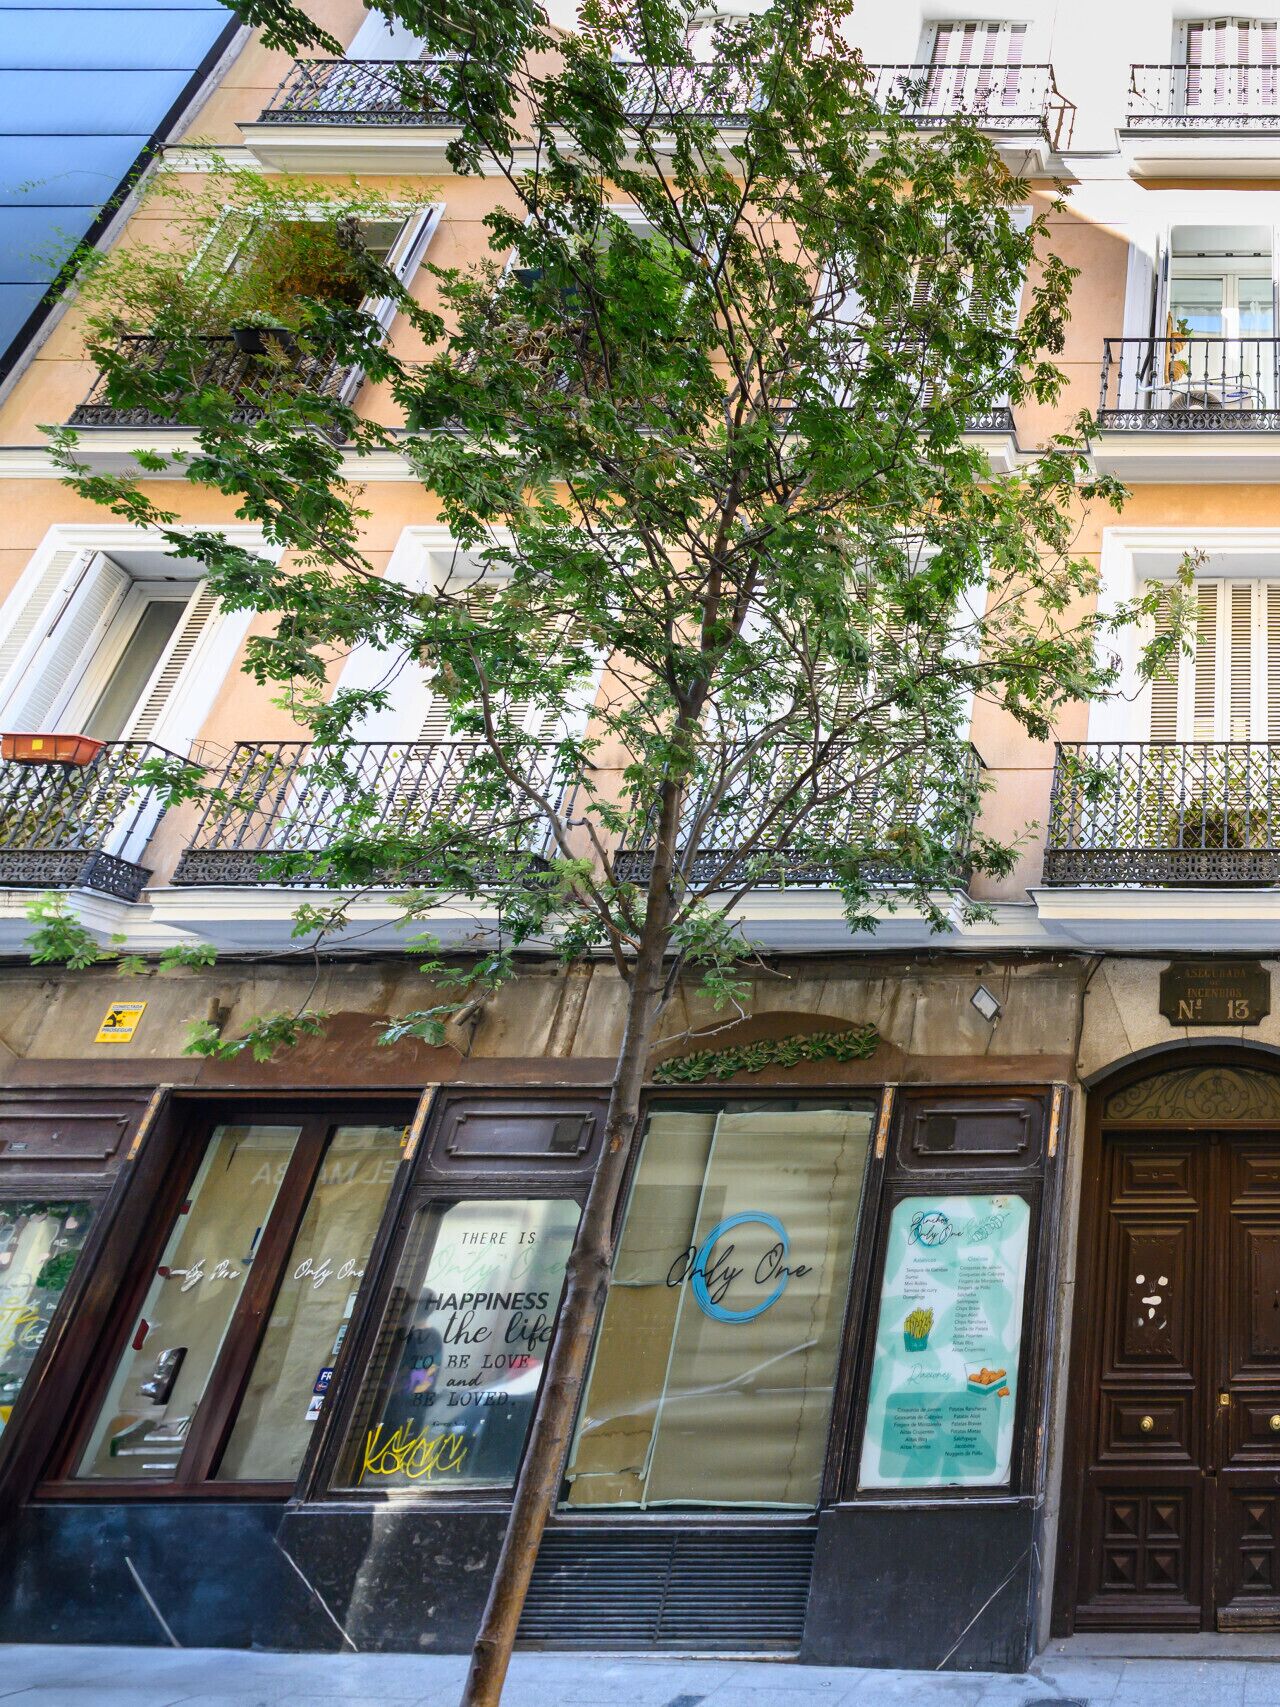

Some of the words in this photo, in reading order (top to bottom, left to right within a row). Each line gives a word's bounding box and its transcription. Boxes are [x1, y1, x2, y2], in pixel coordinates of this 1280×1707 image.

[1186, 987, 1242, 998] INCENDIOS
[1226, 999, 1250, 1020] 13
[461, 1231, 508, 1245] THERE
[518, 1231, 536, 1245] IS
[938, 1223, 964, 1246] One
[293, 1258, 333, 1289] Only
[666, 1244, 744, 1305] Only
[754, 1242, 813, 1285] One
[425, 1292, 550, 1311] HAPPINESS
[442, 1310, 493, 1345] the
[504, 1311, 553, 1352] life
[412, 1354, 434, 1370] TO
[447, 1354, 471, 1369] BE
[481, 1353, 531, 1369] LOVE
[446, 1371, 483, 1388] and
[411, 1391, 435, 1407] BE
[446, 1391, 517, 1407] LOVED.
